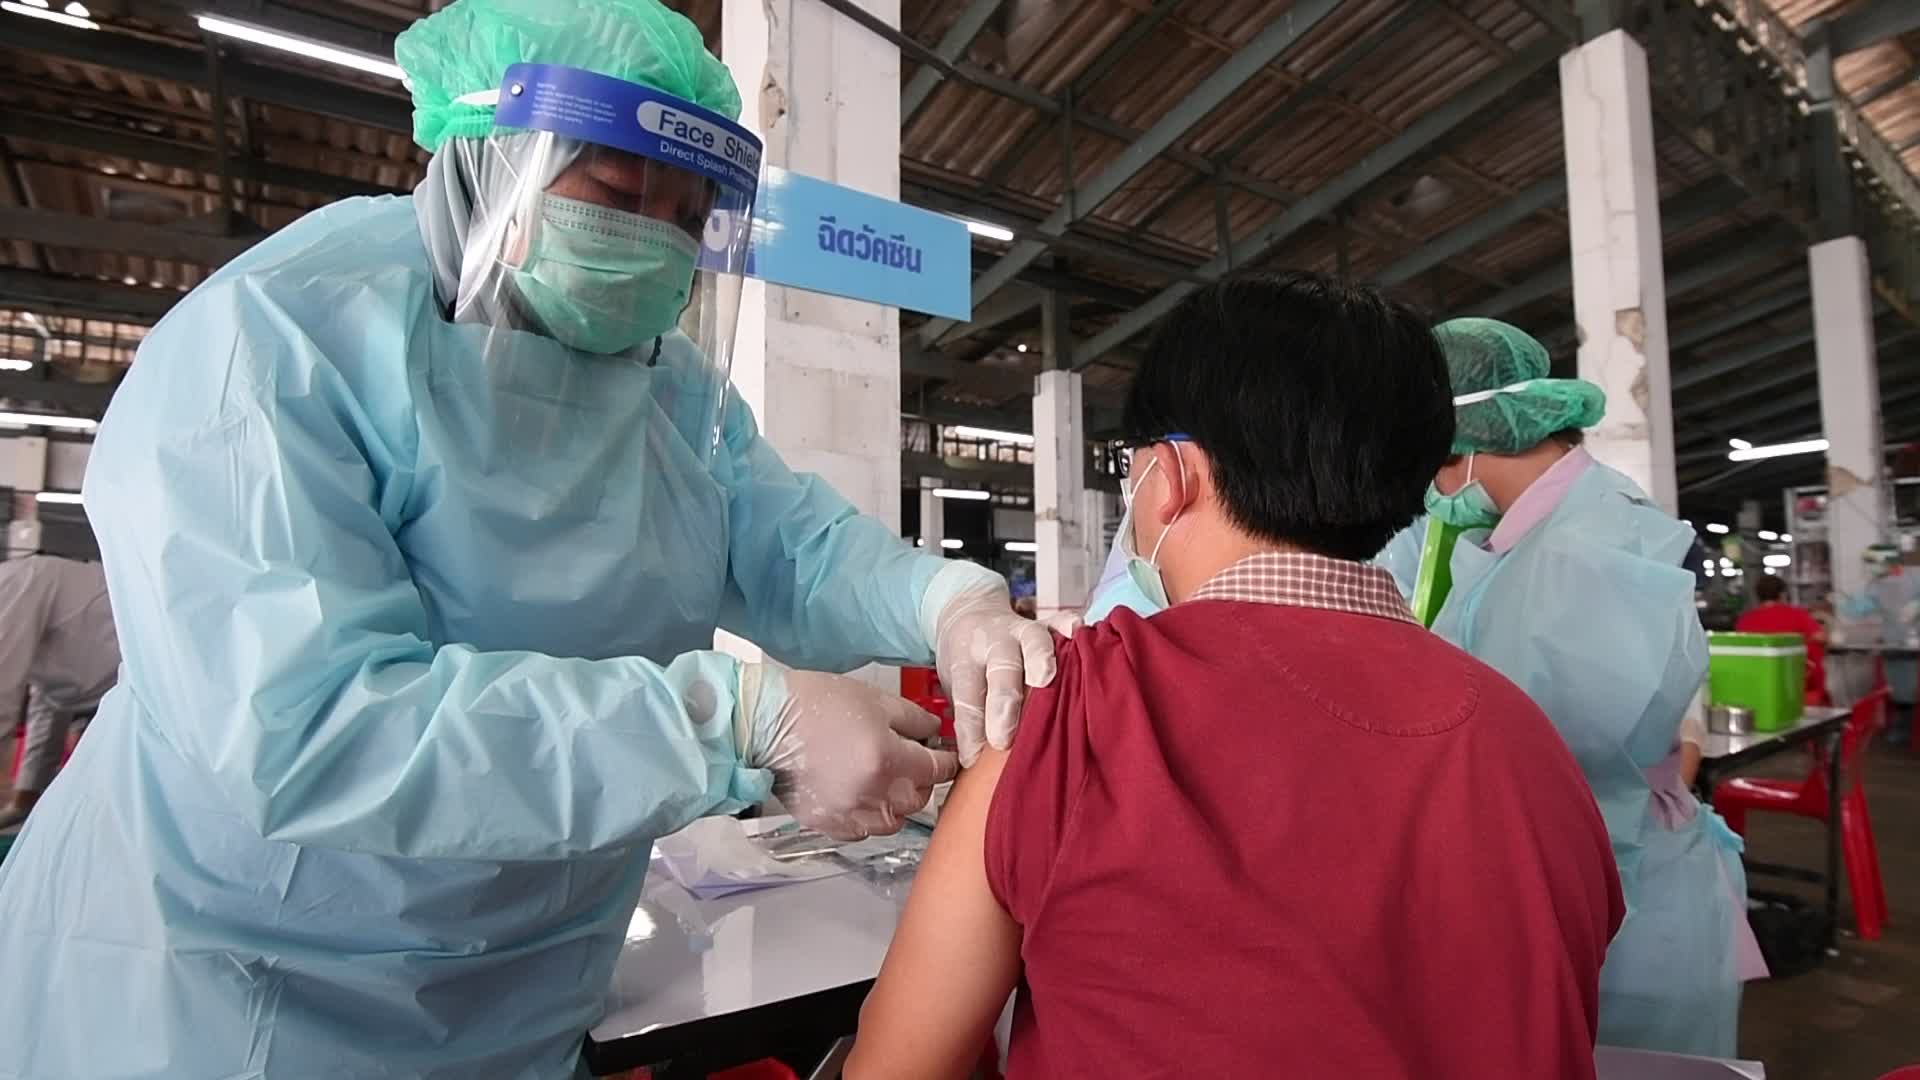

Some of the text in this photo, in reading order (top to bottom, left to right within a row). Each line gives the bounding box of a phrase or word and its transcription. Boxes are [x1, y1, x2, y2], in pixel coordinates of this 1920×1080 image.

[659, 109, 715, 149] Face
[660, 140, 728, 177] Direct Splash
[818, 215, 922, 274] ฉีดวัคซีน
